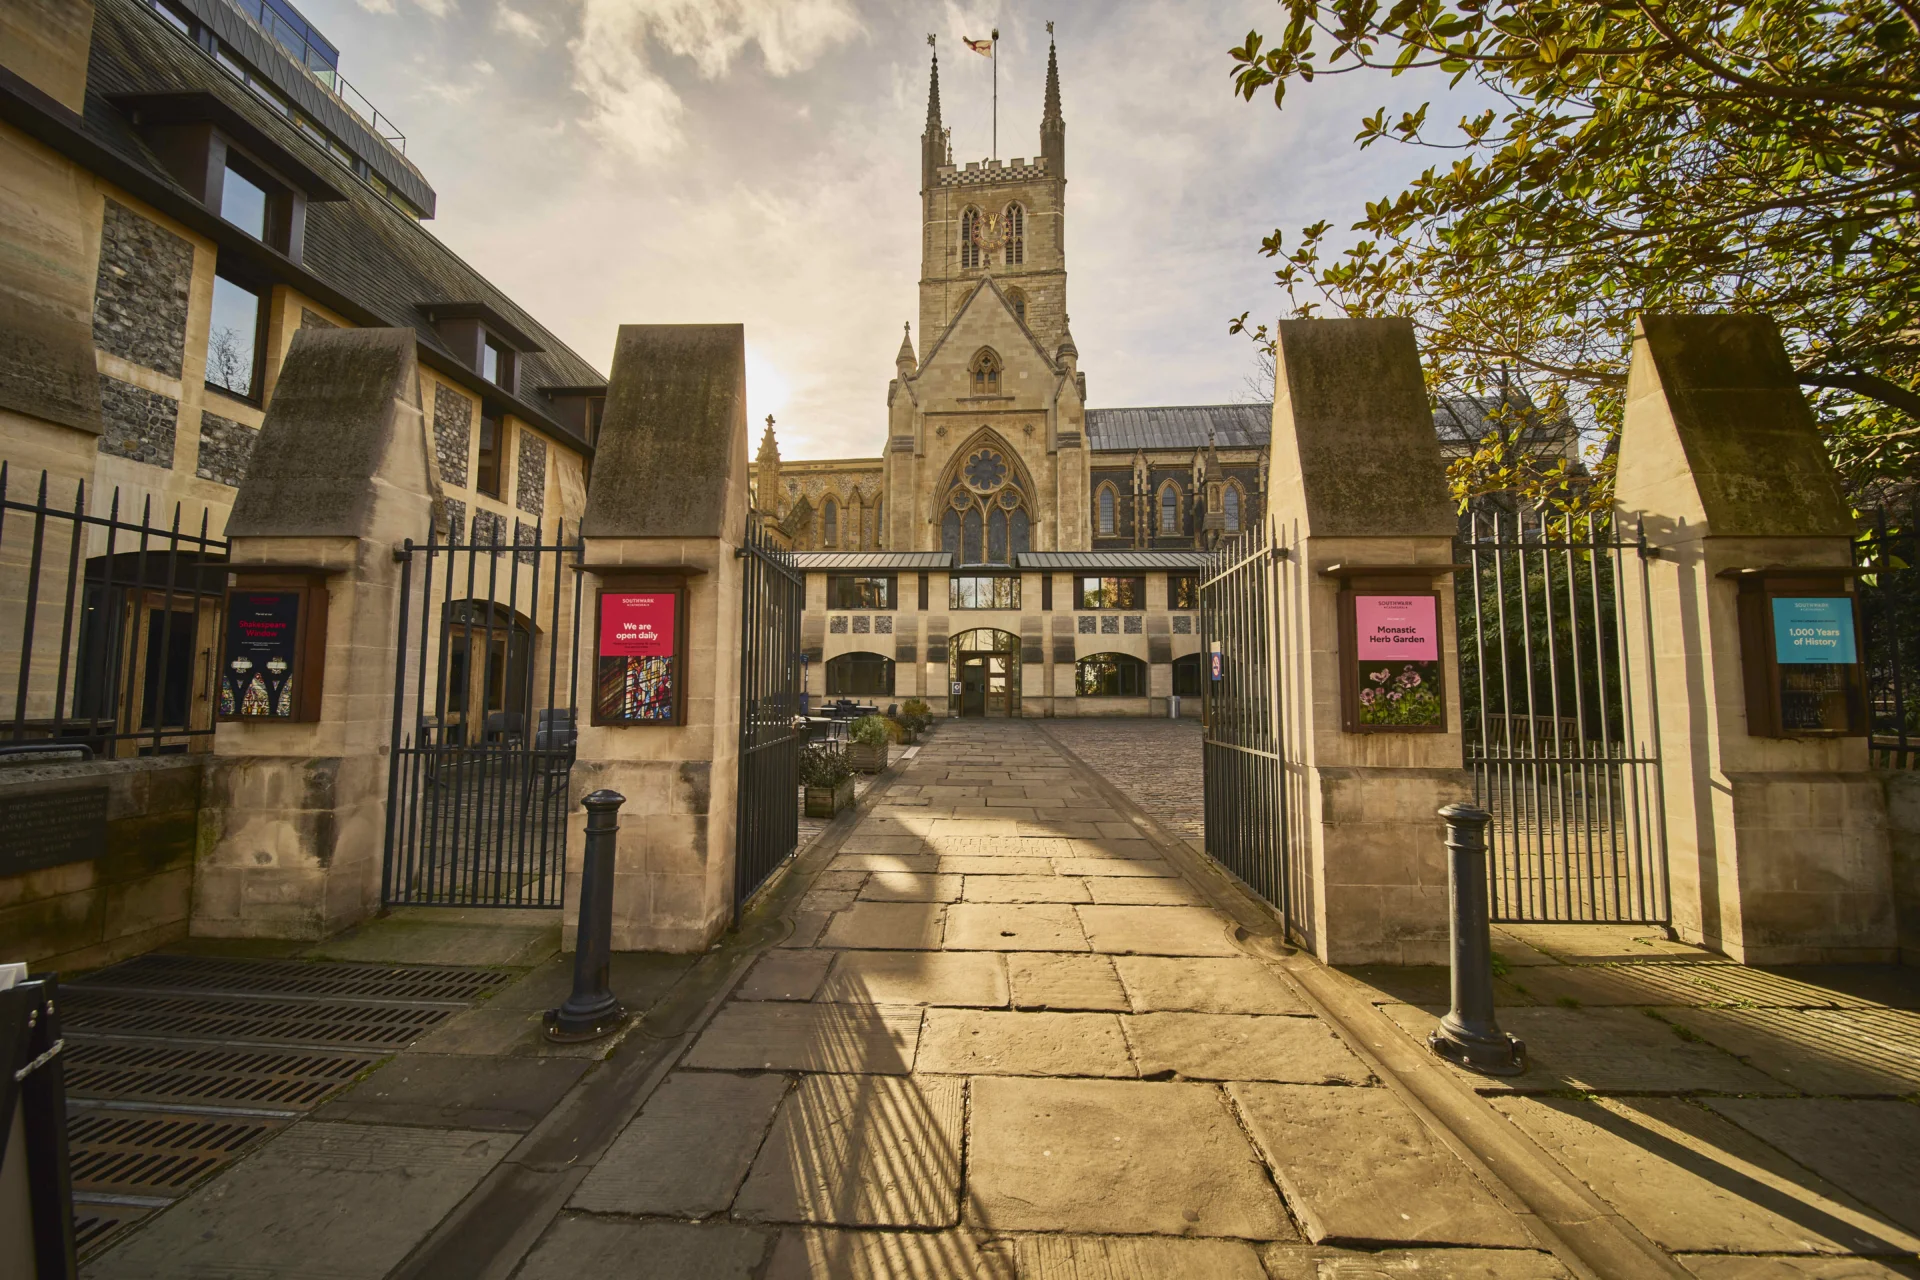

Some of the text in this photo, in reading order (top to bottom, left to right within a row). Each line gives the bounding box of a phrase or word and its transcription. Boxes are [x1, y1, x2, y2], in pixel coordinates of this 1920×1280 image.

[460, 614, 476, 623] Ce
[239, 620, 286, 629] Shakespeare
[623, 622, 637, 630] We
[246, 629, 278, 637] Window
[1377, 626, 1416, 634] Monastic
[1789, 628, 1840, 637] 1,000 Years
[616, 631, 658, 641] open daily
[1369, 635, 1425, 643] Herb Garden
[1793, 637, 1837, 647] of History
